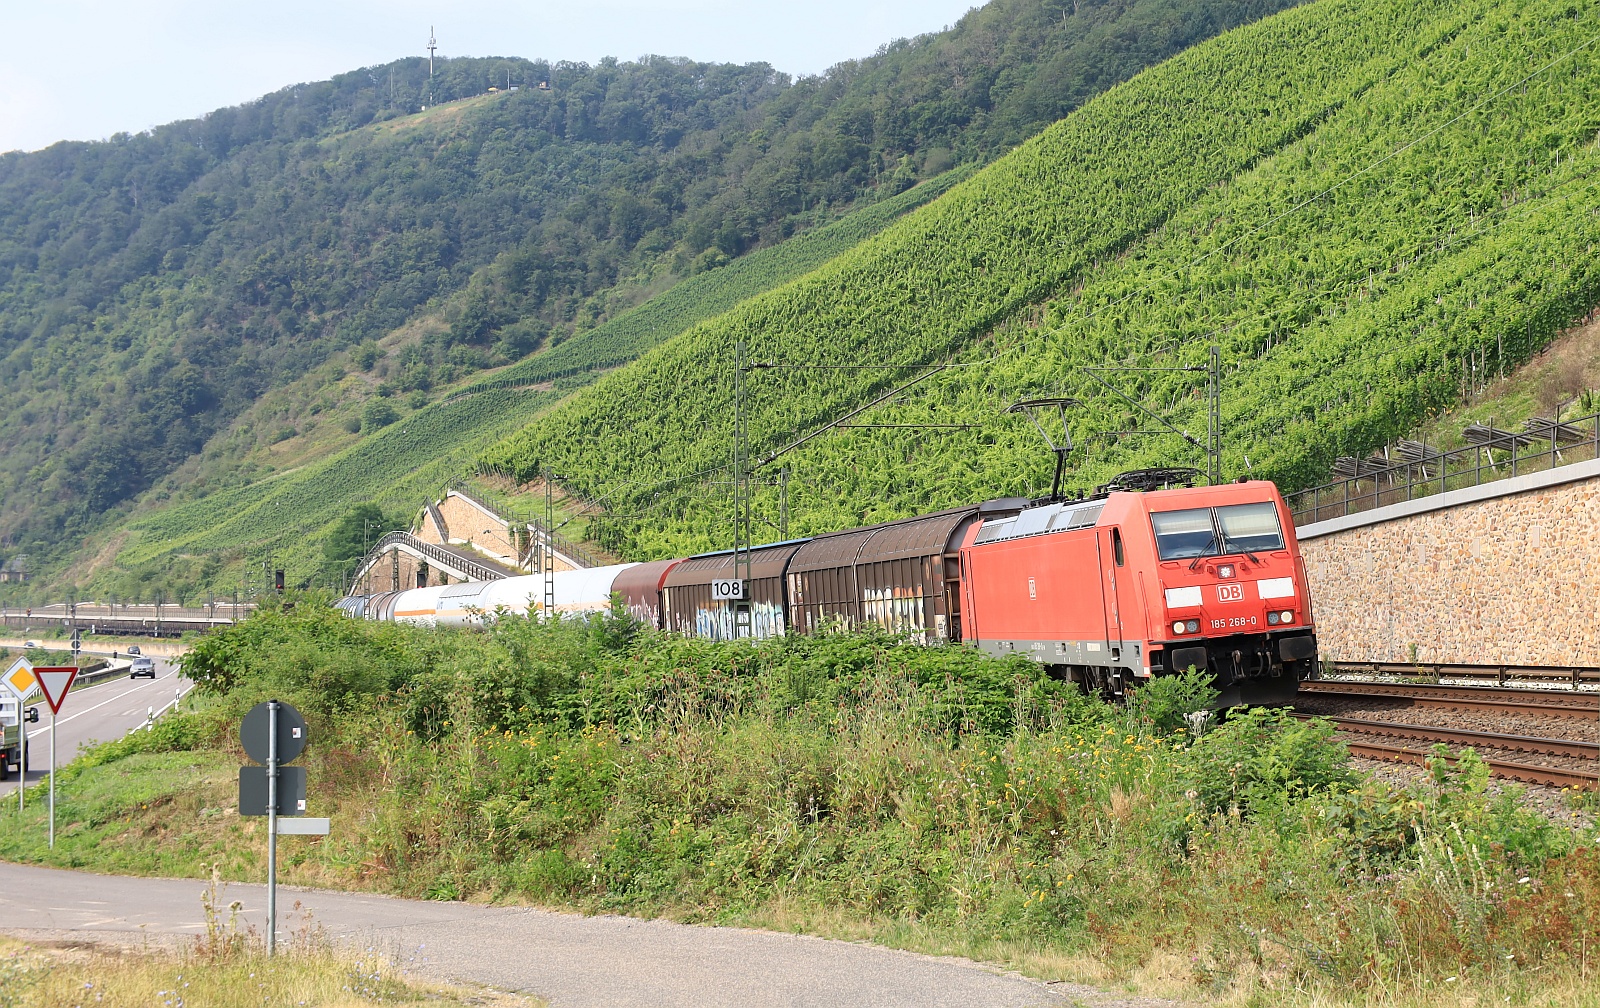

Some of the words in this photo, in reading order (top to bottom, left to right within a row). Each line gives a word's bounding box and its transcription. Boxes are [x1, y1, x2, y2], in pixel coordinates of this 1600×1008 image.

[714, 582, 740, 596] 108
[1219, 586, 1241, 600] DB
[1210, 618, 1226, 629] 185
[1228, 615, 1257, 627] 268-0
